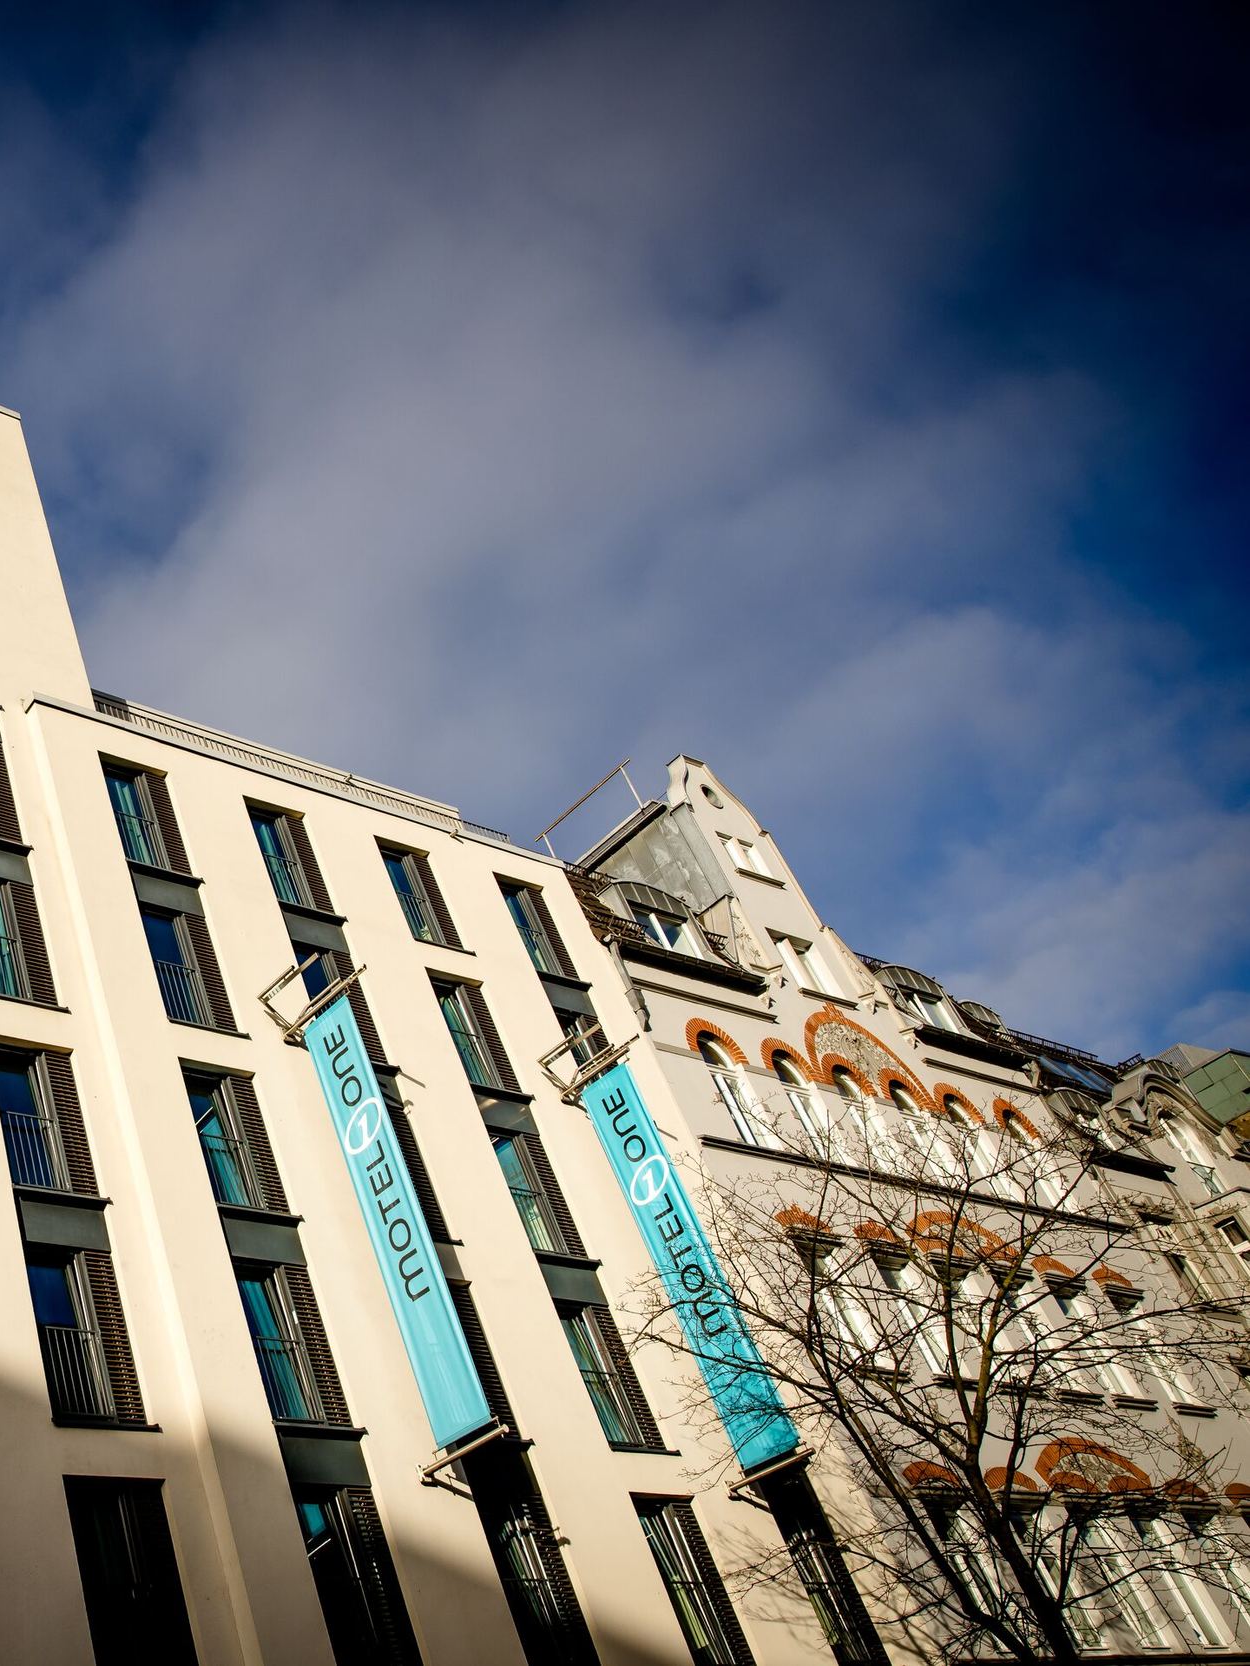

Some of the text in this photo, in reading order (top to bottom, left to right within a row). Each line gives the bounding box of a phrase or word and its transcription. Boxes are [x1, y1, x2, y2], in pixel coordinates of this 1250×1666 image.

[323, 1024, 362, 1107] ONE
[602, 1088, 646, 1163] ONE
[366, 1139, 430, 1302] MOTEL
